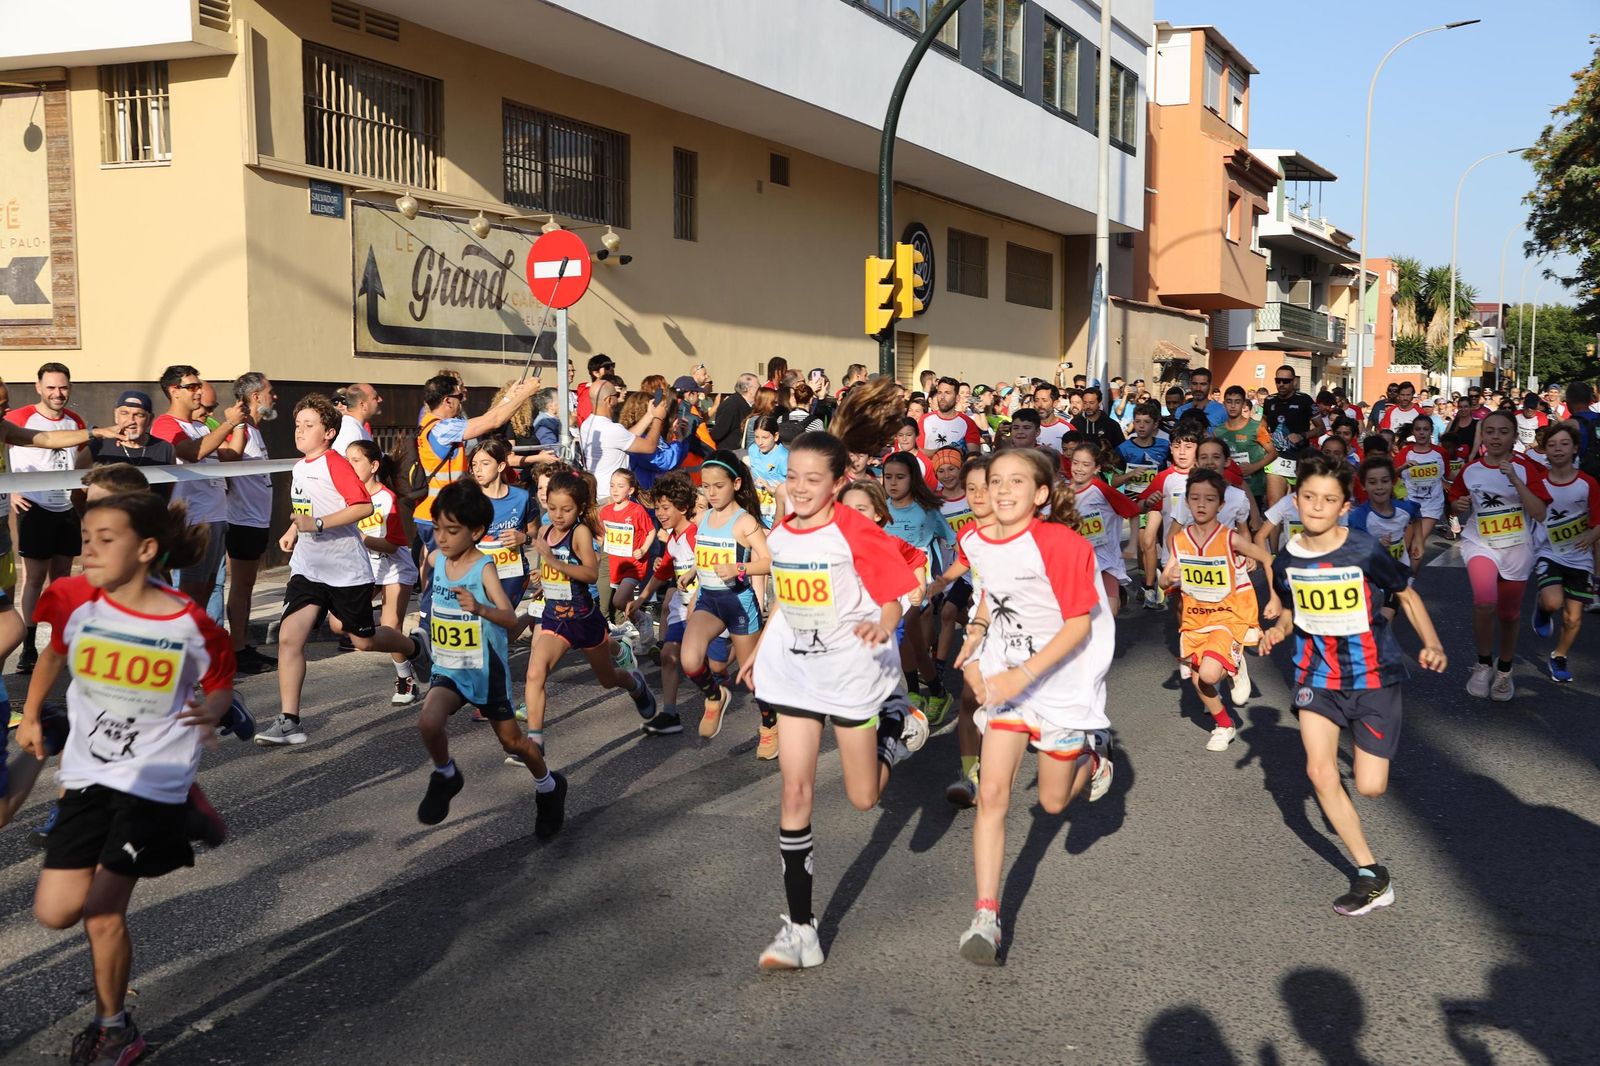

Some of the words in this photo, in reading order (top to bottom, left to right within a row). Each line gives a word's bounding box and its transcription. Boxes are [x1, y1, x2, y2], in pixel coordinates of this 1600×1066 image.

[311, 203, 335, 215] ALLENDE
[395, 231, 414, 253] LE
[408, 244, 515, 322] Grand
[1410, 466, 1438, 478] 1089
[1480, 515, 1523, 535] 1144
[607, 532, 632, 545] 142
[1184, 568, 1226, 586] 1041
[776, 576, 829, 602] 1108
[1297, 587, 1359, 611] 1019
[432, 622, 477, 647] 1031
[79, 645, 175, 688] 1109
